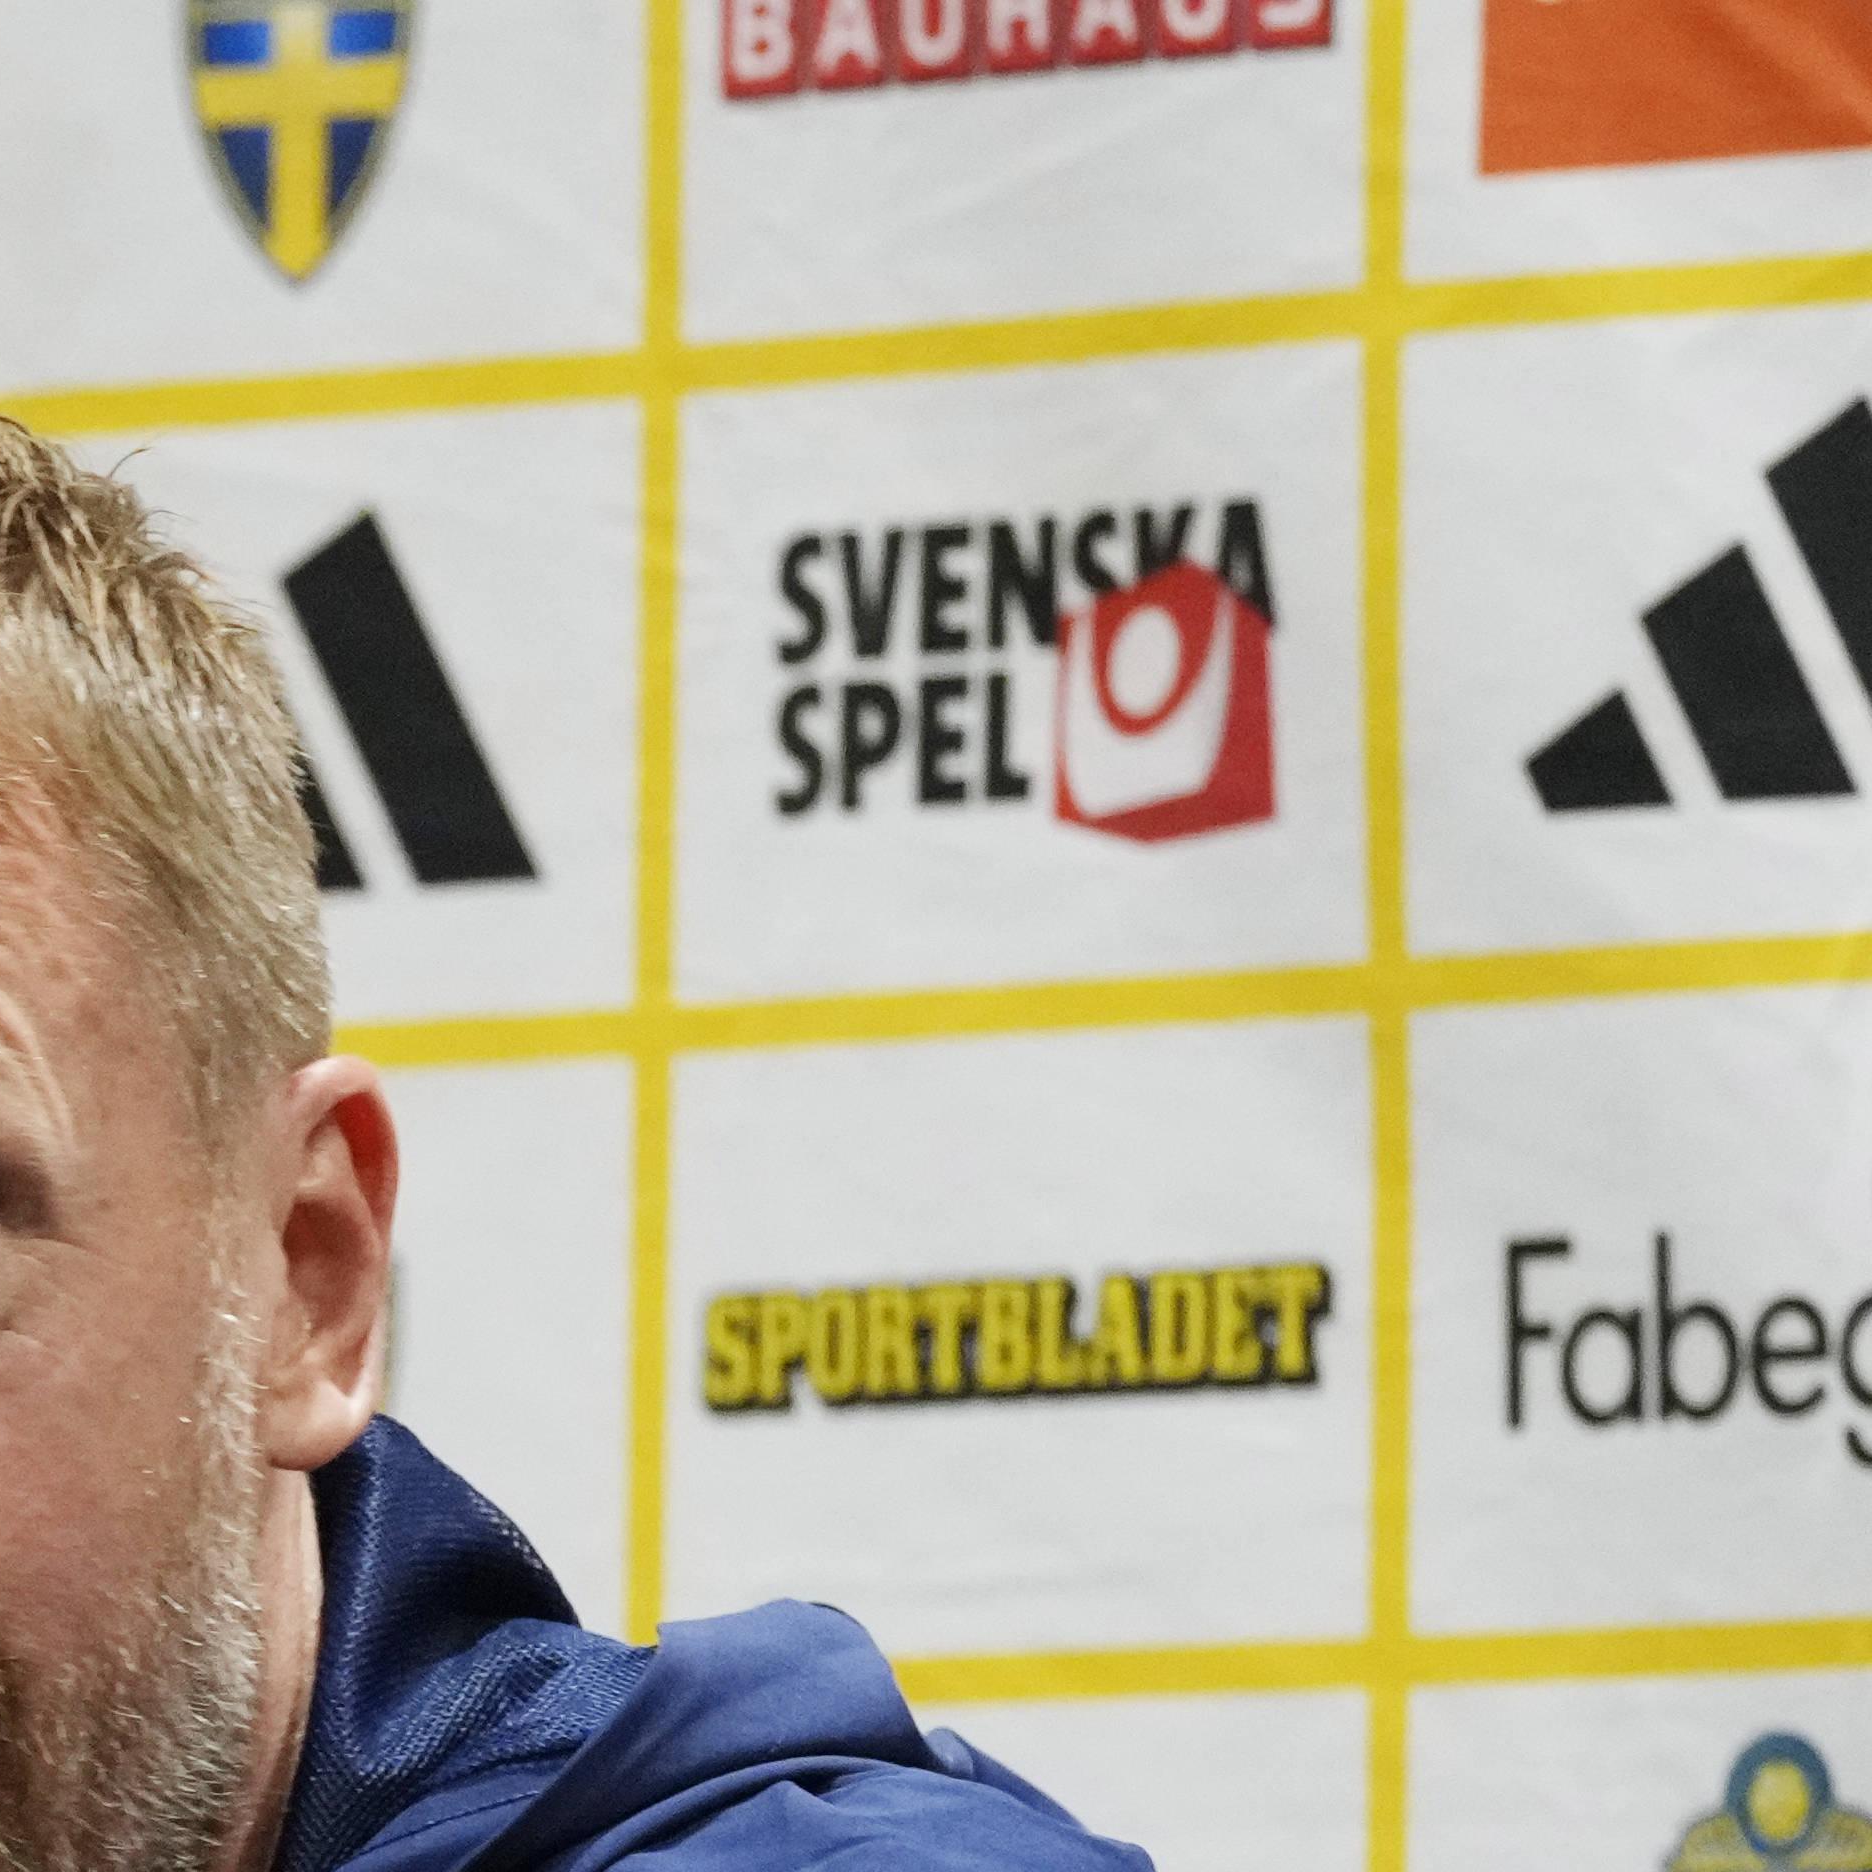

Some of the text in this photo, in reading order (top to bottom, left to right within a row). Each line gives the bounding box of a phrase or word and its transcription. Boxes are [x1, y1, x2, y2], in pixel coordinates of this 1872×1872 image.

[778, 497, 1279, 664] SVENSKA
[778, 672, 1030, 814] SPEL
[703, 1262, 1329, 1414] SPORTBLADET
